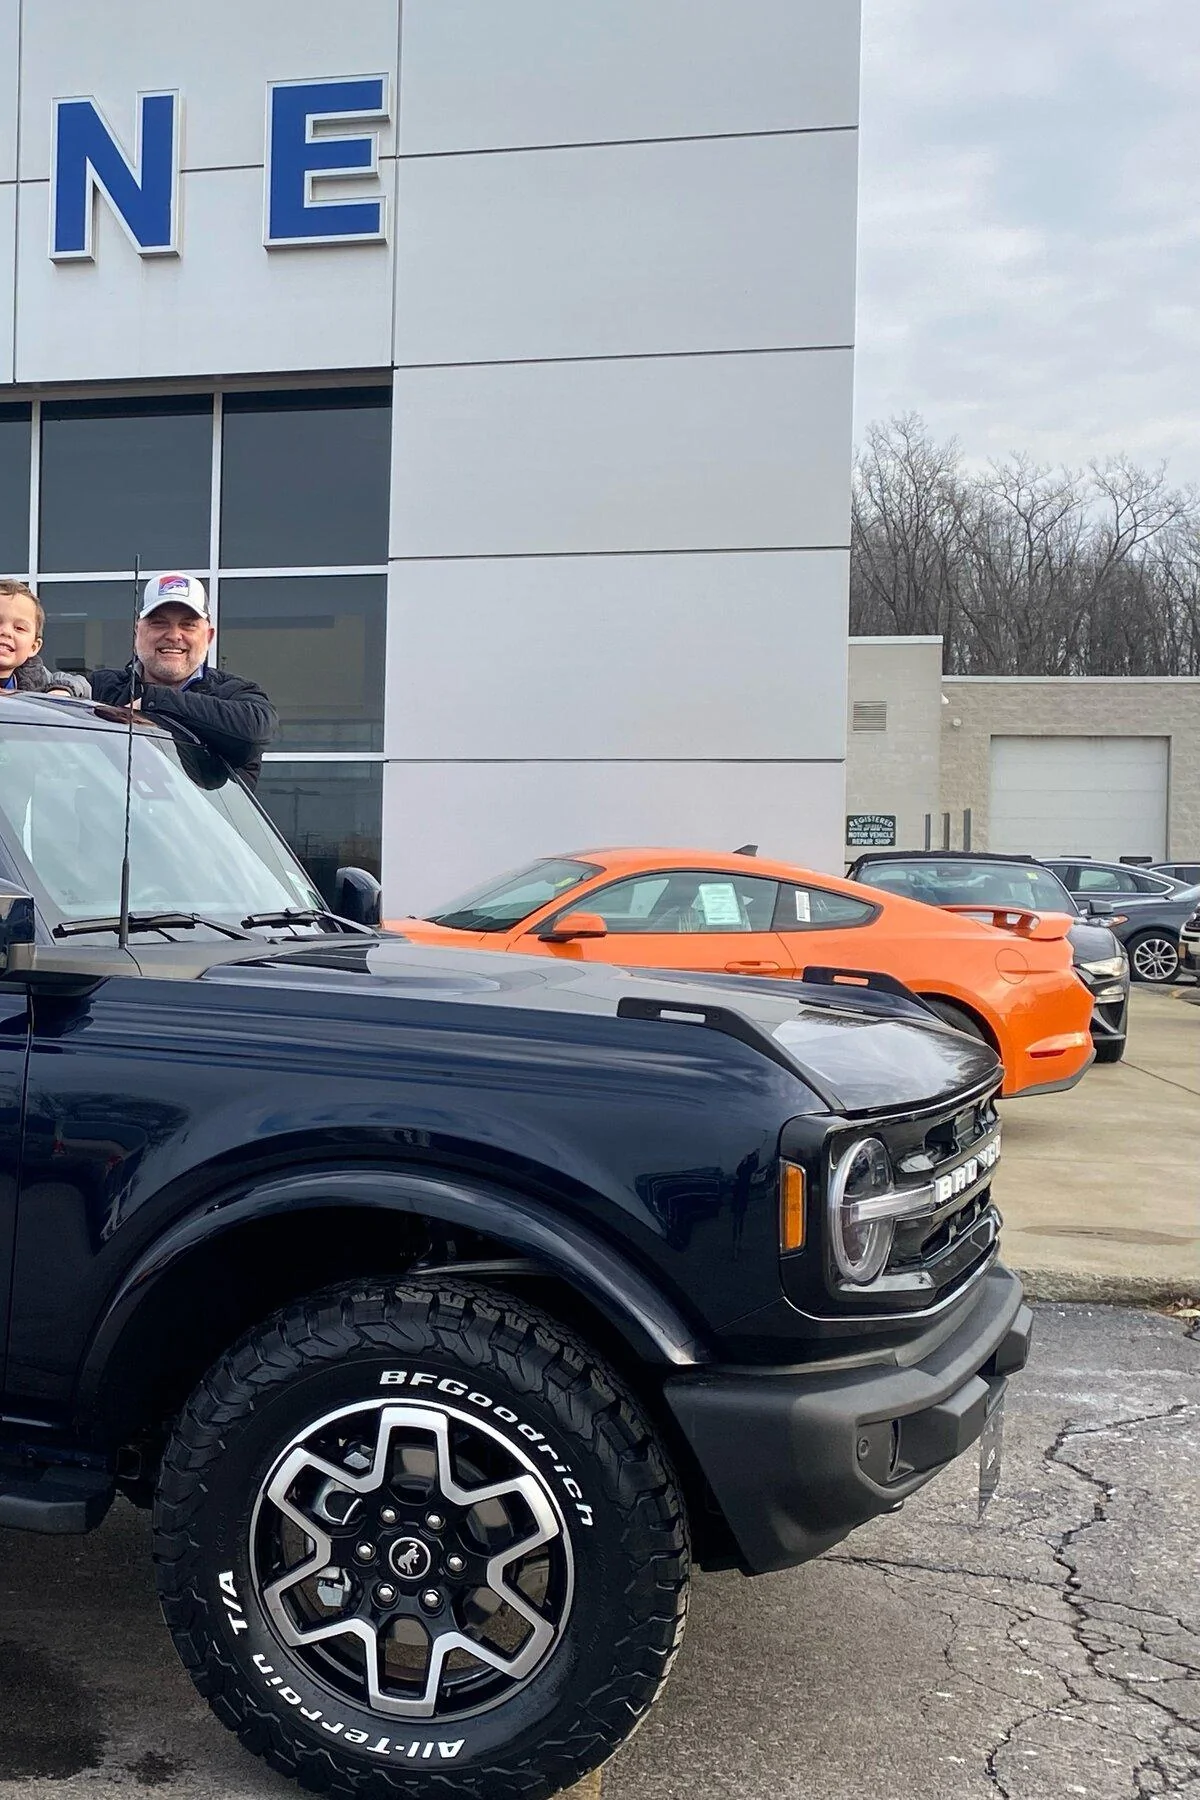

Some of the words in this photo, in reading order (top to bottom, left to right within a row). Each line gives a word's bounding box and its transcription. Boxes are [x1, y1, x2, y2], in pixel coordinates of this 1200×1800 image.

[848, 815, 894, 828] REGISTERED
[379, 1370, 594, 1527] BFGoodrich
[218, 1570, 248, 1635] T/A
[252, 1653, 466, 1759] All-Terrain
